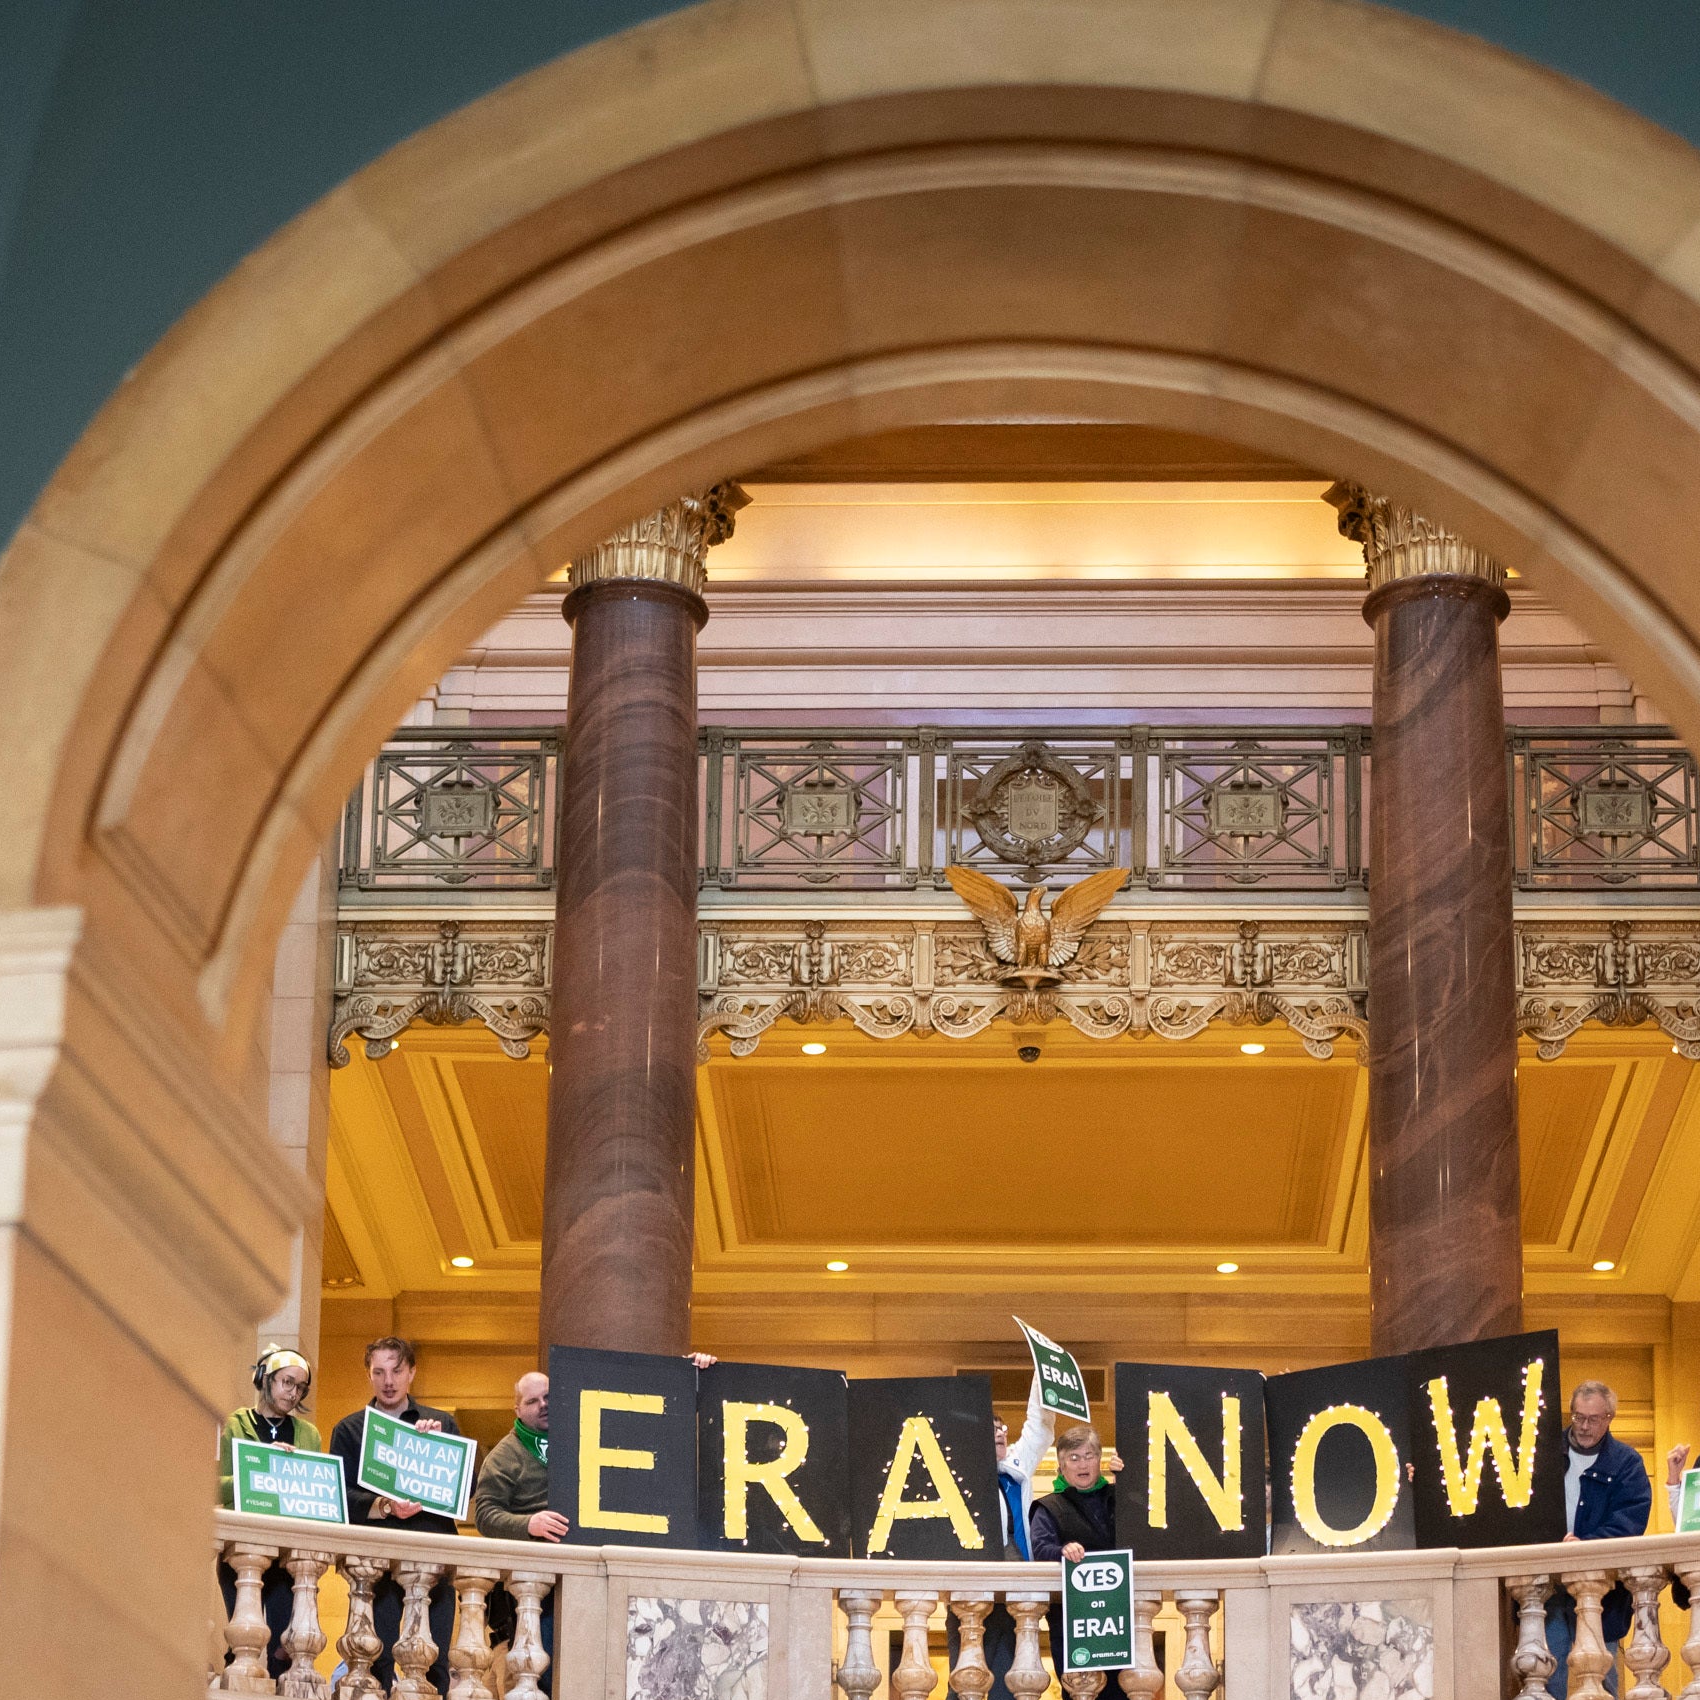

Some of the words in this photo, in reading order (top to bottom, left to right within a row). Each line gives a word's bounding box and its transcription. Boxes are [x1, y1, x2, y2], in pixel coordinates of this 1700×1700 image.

[1041, 1363, 1079, 1391] ERA!
[396, 1433, 401, 1448] I
[404, 1437, 430, 1458] AM
[435, 1447, 460, 1465] AN
[579, 1390, 989, 1559] ERA
[1146, 1357, 1547, 1548] NOW
[272, 1458, 277, 1473] I
[282, 1460, 307, 1477] AM
[313, 1465, 336, 1481] AN
[377, 1445, 457, 1484] EQUALITY
[253, 1474, 337, 1500] EQUALITY
[399, 1474, 453, 1504] VOTER
[282, 1498, 339, 1519] VOTER
[1077, 1568, 1118, 1587] YES
[1091, 1600, 1106, 1608] on
[1073, 1616, 1124, 1638] ERA!
[1092, 1651, 1128, 1659] eramn.org
